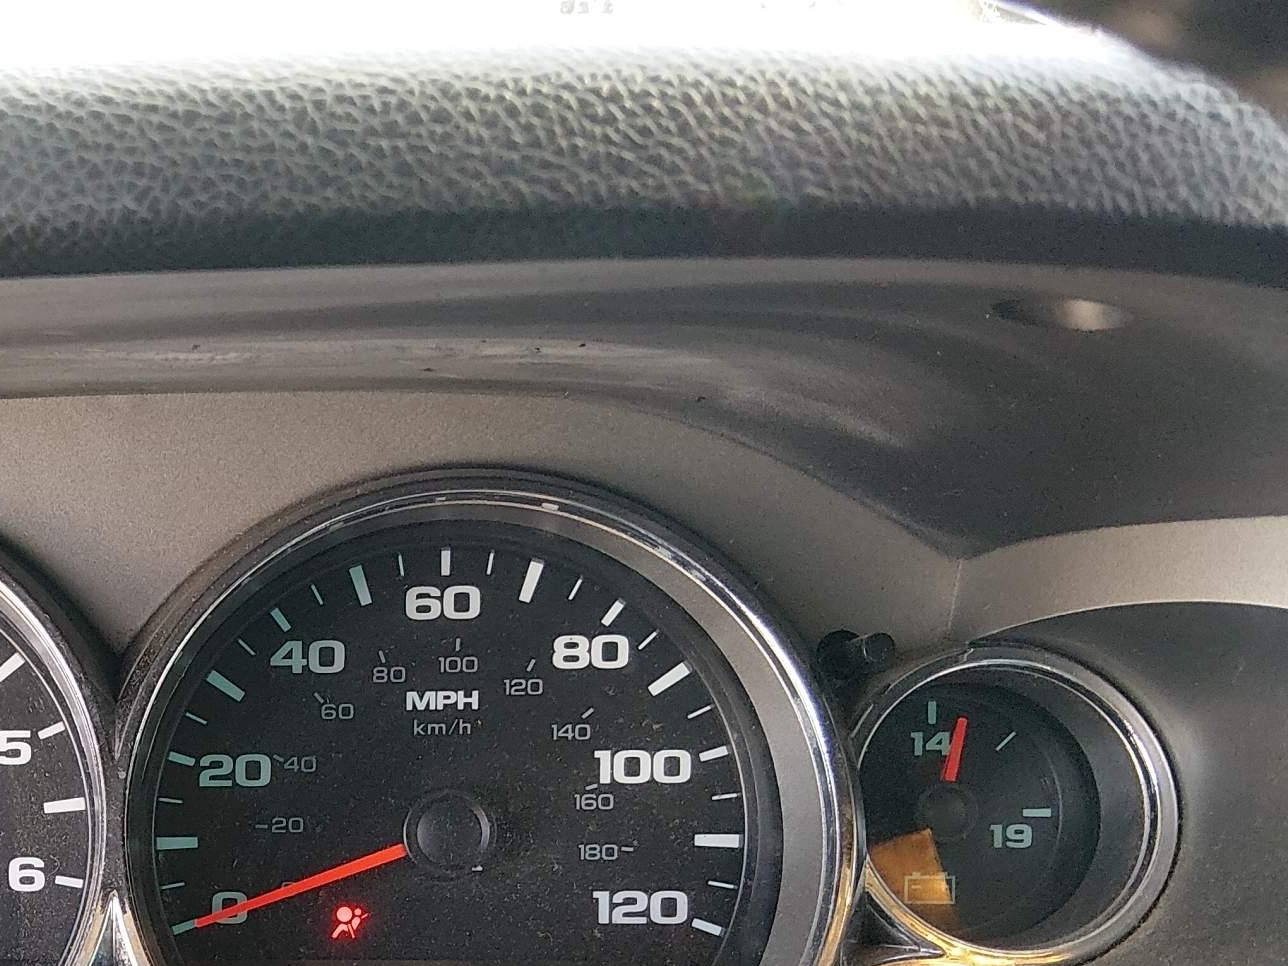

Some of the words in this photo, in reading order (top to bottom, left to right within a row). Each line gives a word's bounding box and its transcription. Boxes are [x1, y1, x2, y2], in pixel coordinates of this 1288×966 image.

[406, 586, 480, 620] 60
[271, 640, 345, 674] 40
[553, 635, 629, 669] 80
[373, 665, 406, 682] 80
[438, 657, 478, 673] 100
[504, 679, 543, 696] 120
[406, 691, 479, 711] MPH
[321, 704, 354, 720] 60
[414, 718, 472, 736] km/h
[552, 724, 591, 741] 140
[911, 732, 948, 756] 14
[200, 753, 271, 787] 20
[284, 756, 317, 773] 40
[594, 750, 691, 783] 100
[574, 793, 613, 810] 160
[271, 817, 304, 834] 20
[990, 824, 1033, 849] 19
[579, 844, 618, 861] 180
[9, 857, 46, 892] 6
[211, 891, 248, 925] 0
[593, 891, 688, 925] 120
